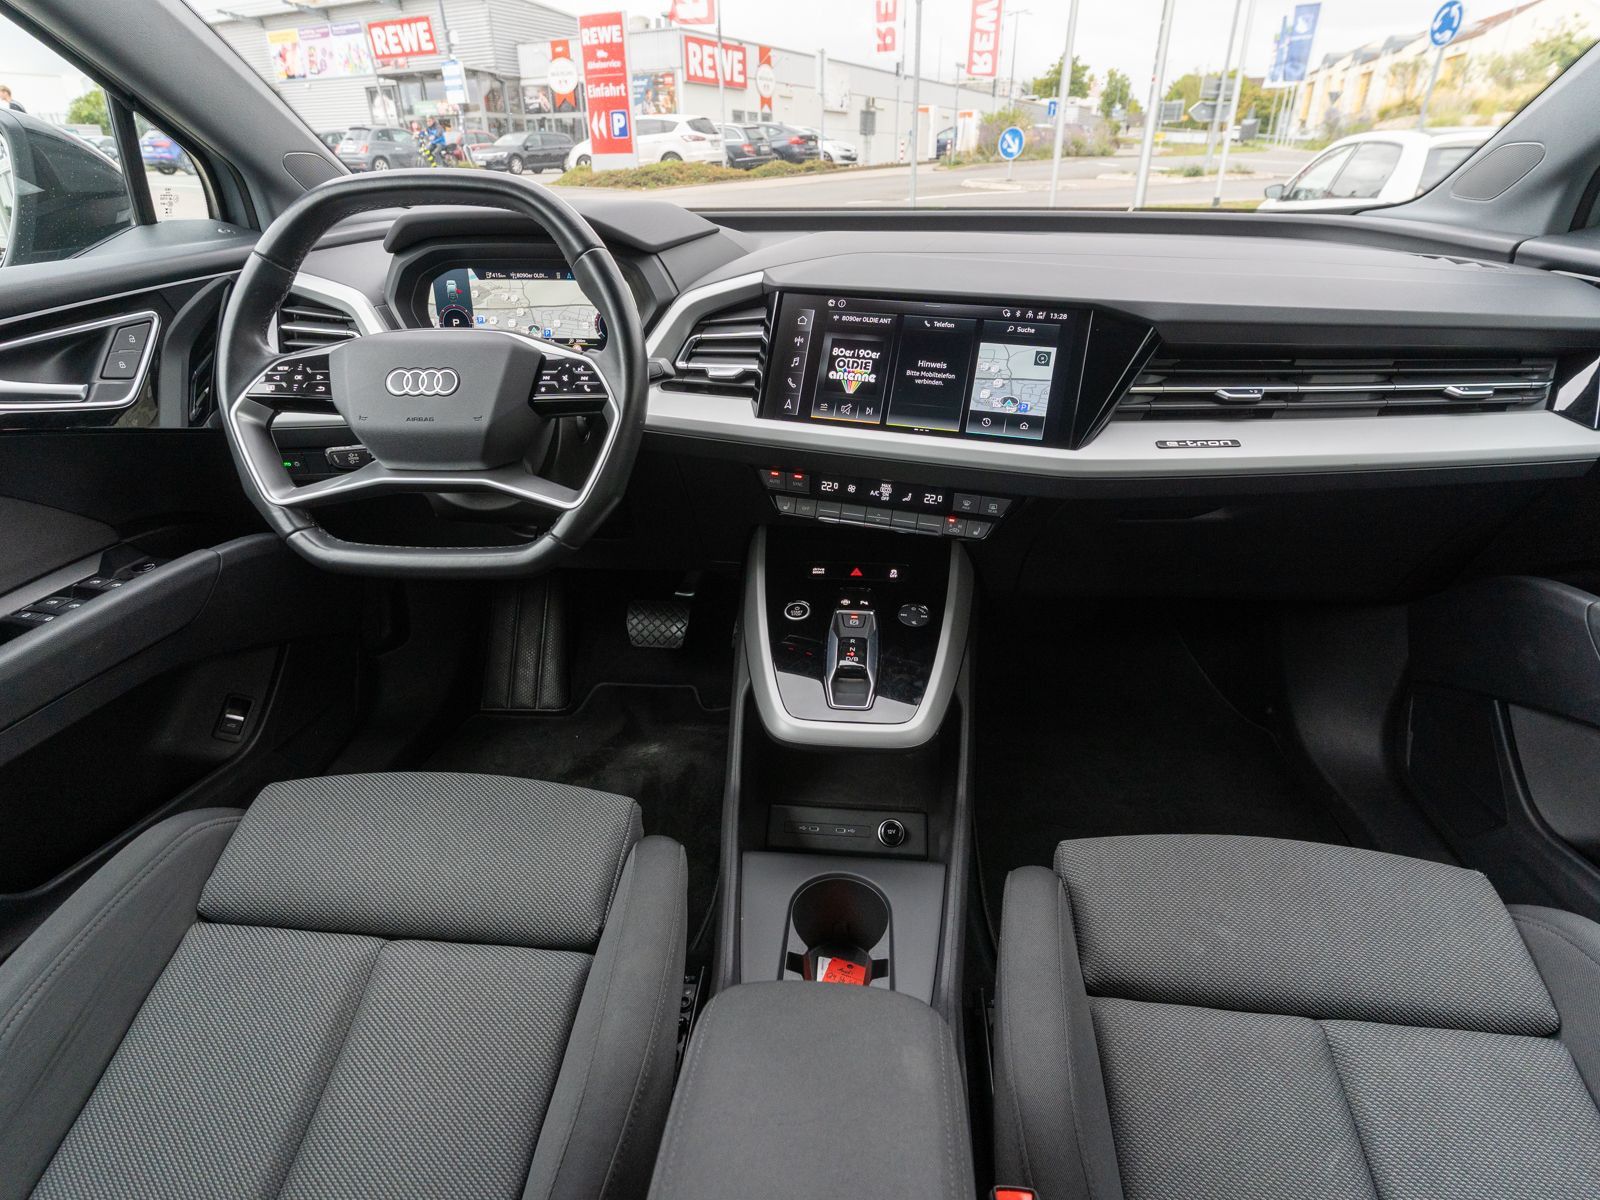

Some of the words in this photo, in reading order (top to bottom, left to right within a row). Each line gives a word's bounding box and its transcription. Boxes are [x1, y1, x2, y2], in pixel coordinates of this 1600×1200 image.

[370, 21, 435, 57] REWE
[581, 24, 623, 46] REWE
[687, 41, 745, 84] REWE
[587, 82, 626, 99] Einfahrt
[835, 358, 873, 371] OLDIE
[917, 360, 947, 370] Hinweis
[828, 370, 876, 383] antenne
[906, 370, 920, 378] Bitte
[920, 371, 956, 380] Mobiltelefon
